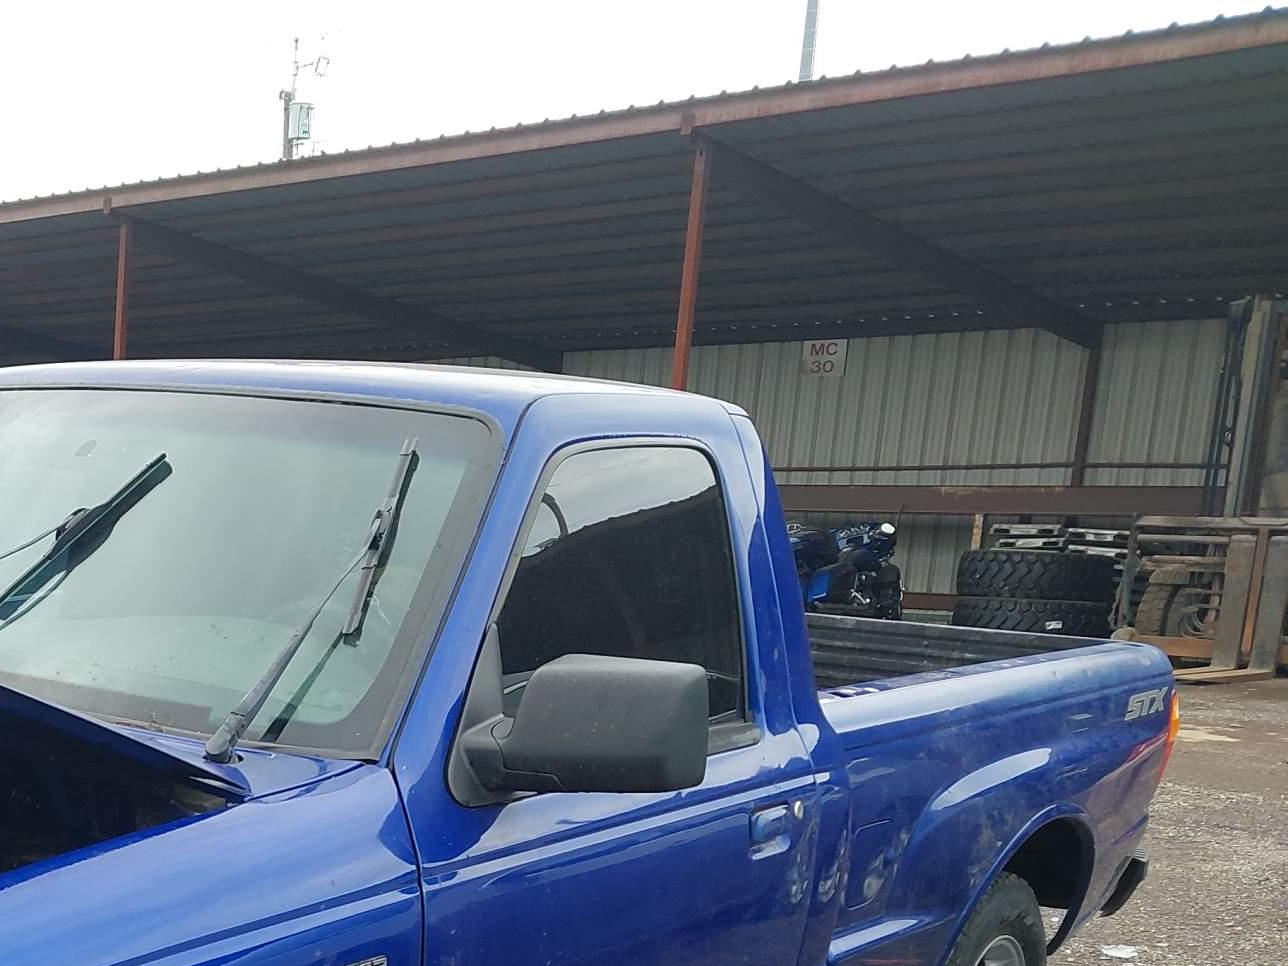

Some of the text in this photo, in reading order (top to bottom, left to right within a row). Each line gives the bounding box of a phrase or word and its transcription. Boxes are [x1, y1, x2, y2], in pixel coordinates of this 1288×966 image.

[810, 342, 838, 356] MC
[810, 360, 834, 373] 30
[1124, 686, 1169, 721] STX
